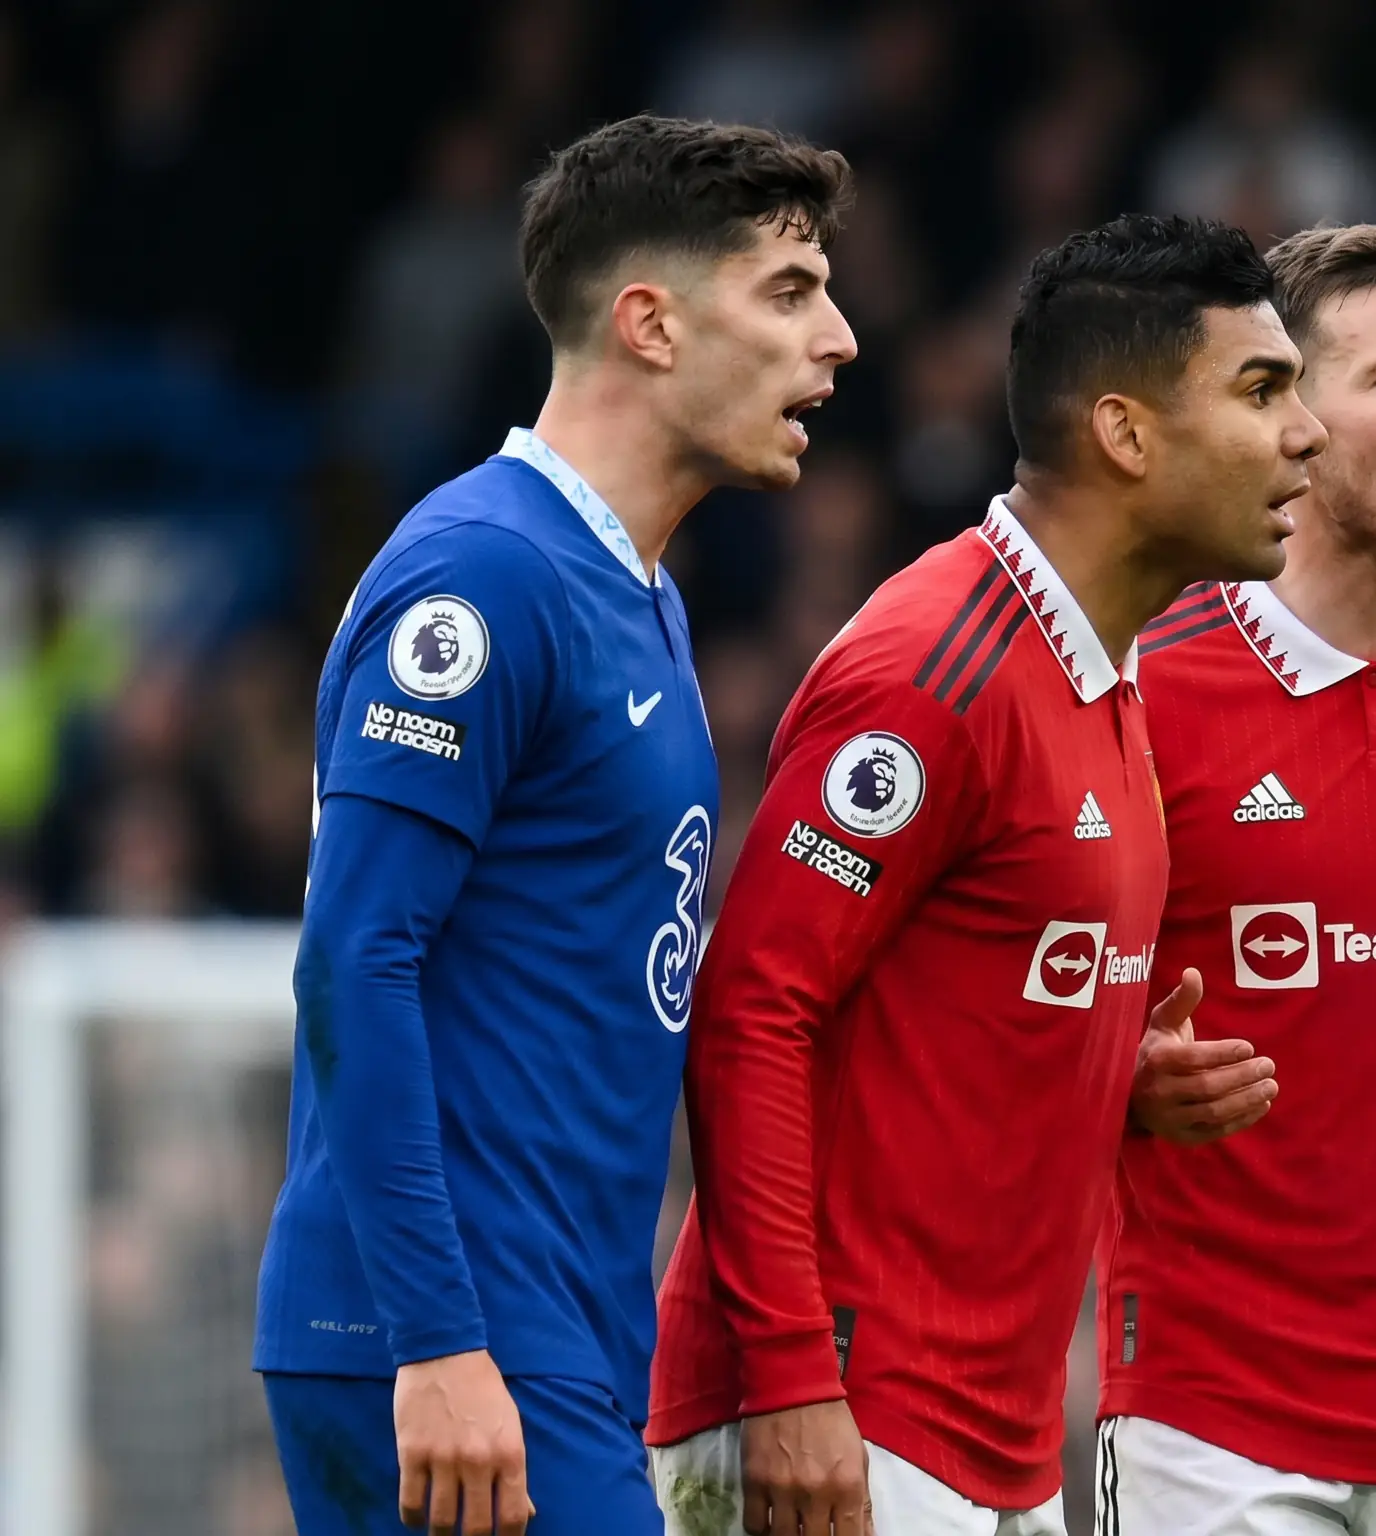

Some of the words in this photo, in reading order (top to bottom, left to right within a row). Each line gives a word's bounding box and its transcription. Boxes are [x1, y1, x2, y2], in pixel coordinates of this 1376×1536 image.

[366, 703, 395, 724] No
[1233, 803, 1305, 822] adidas
[788, 820, 818, 846] No
[817, 838, 871, 878] room
[1104, 943, 1156, 984] TeamV
